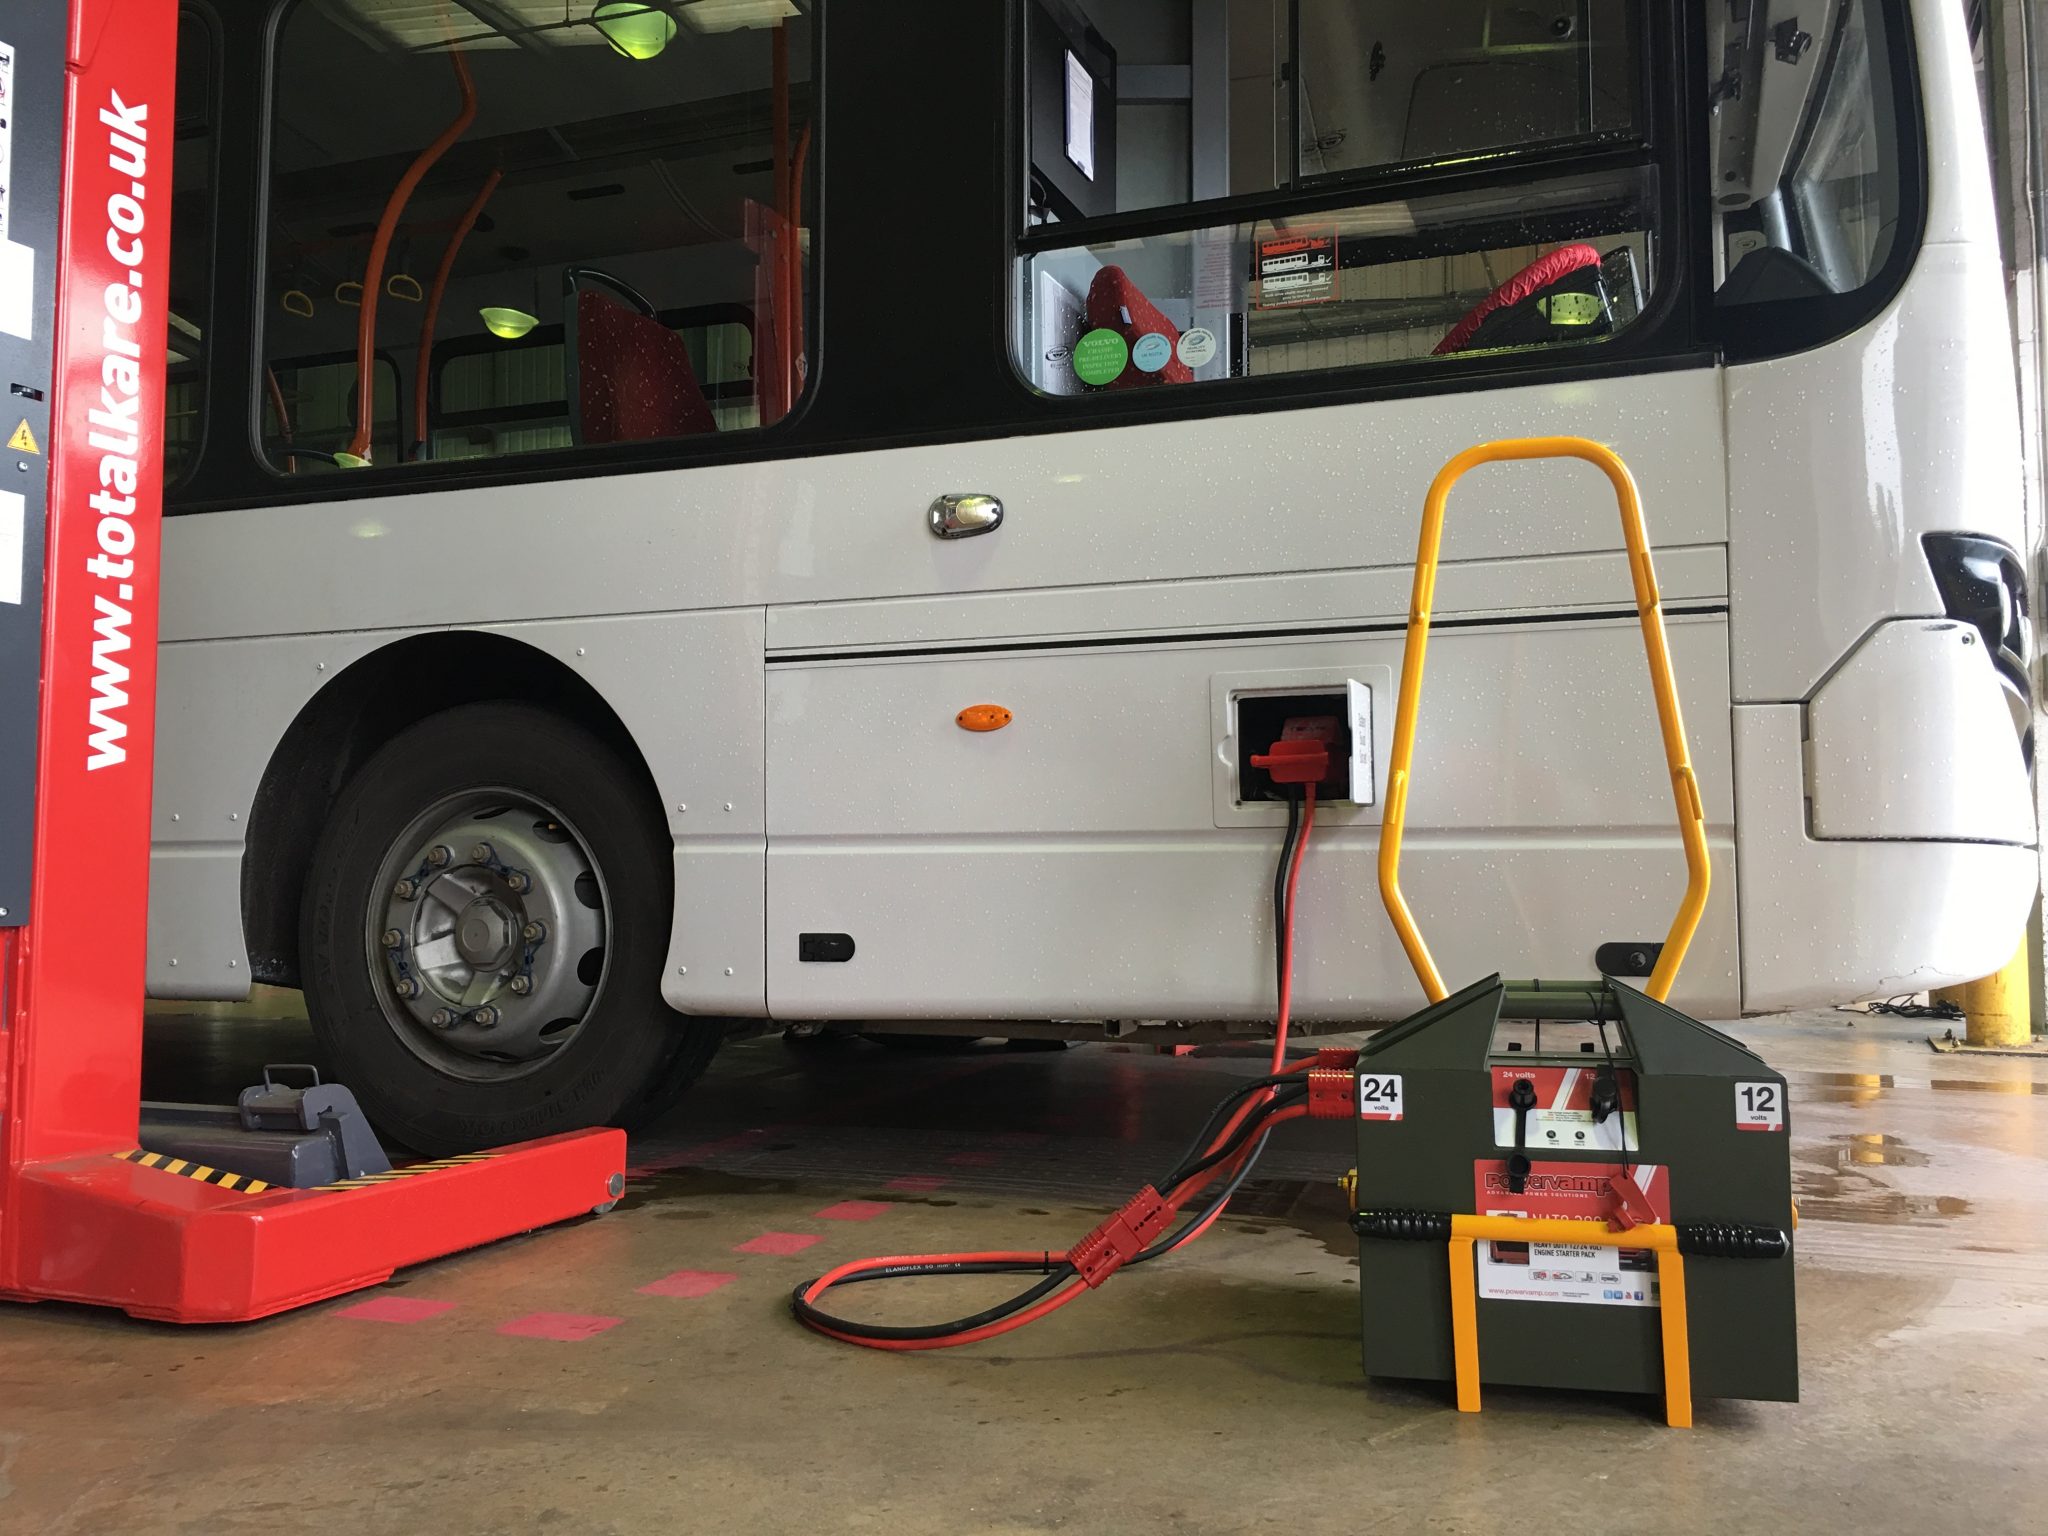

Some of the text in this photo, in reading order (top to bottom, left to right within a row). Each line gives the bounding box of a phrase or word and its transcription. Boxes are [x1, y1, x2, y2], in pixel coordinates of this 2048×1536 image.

[1083, 338, 1119, 347] VOLVO
[87, 87, 148, 772] www.totalkare.co.uk
[1515, 1071, 1536, 1079] volts
[1364, 1077, 1398, 1103] 24
[1741, 1086, 1775, 1112] 12
[1534, 1249, 1596, 1259] ENGINE STARTER PACK
[885, 1264, 922, 1273] ELANDFLEX
[1488, 1287, 1559, 1298] www.powervamp.com
